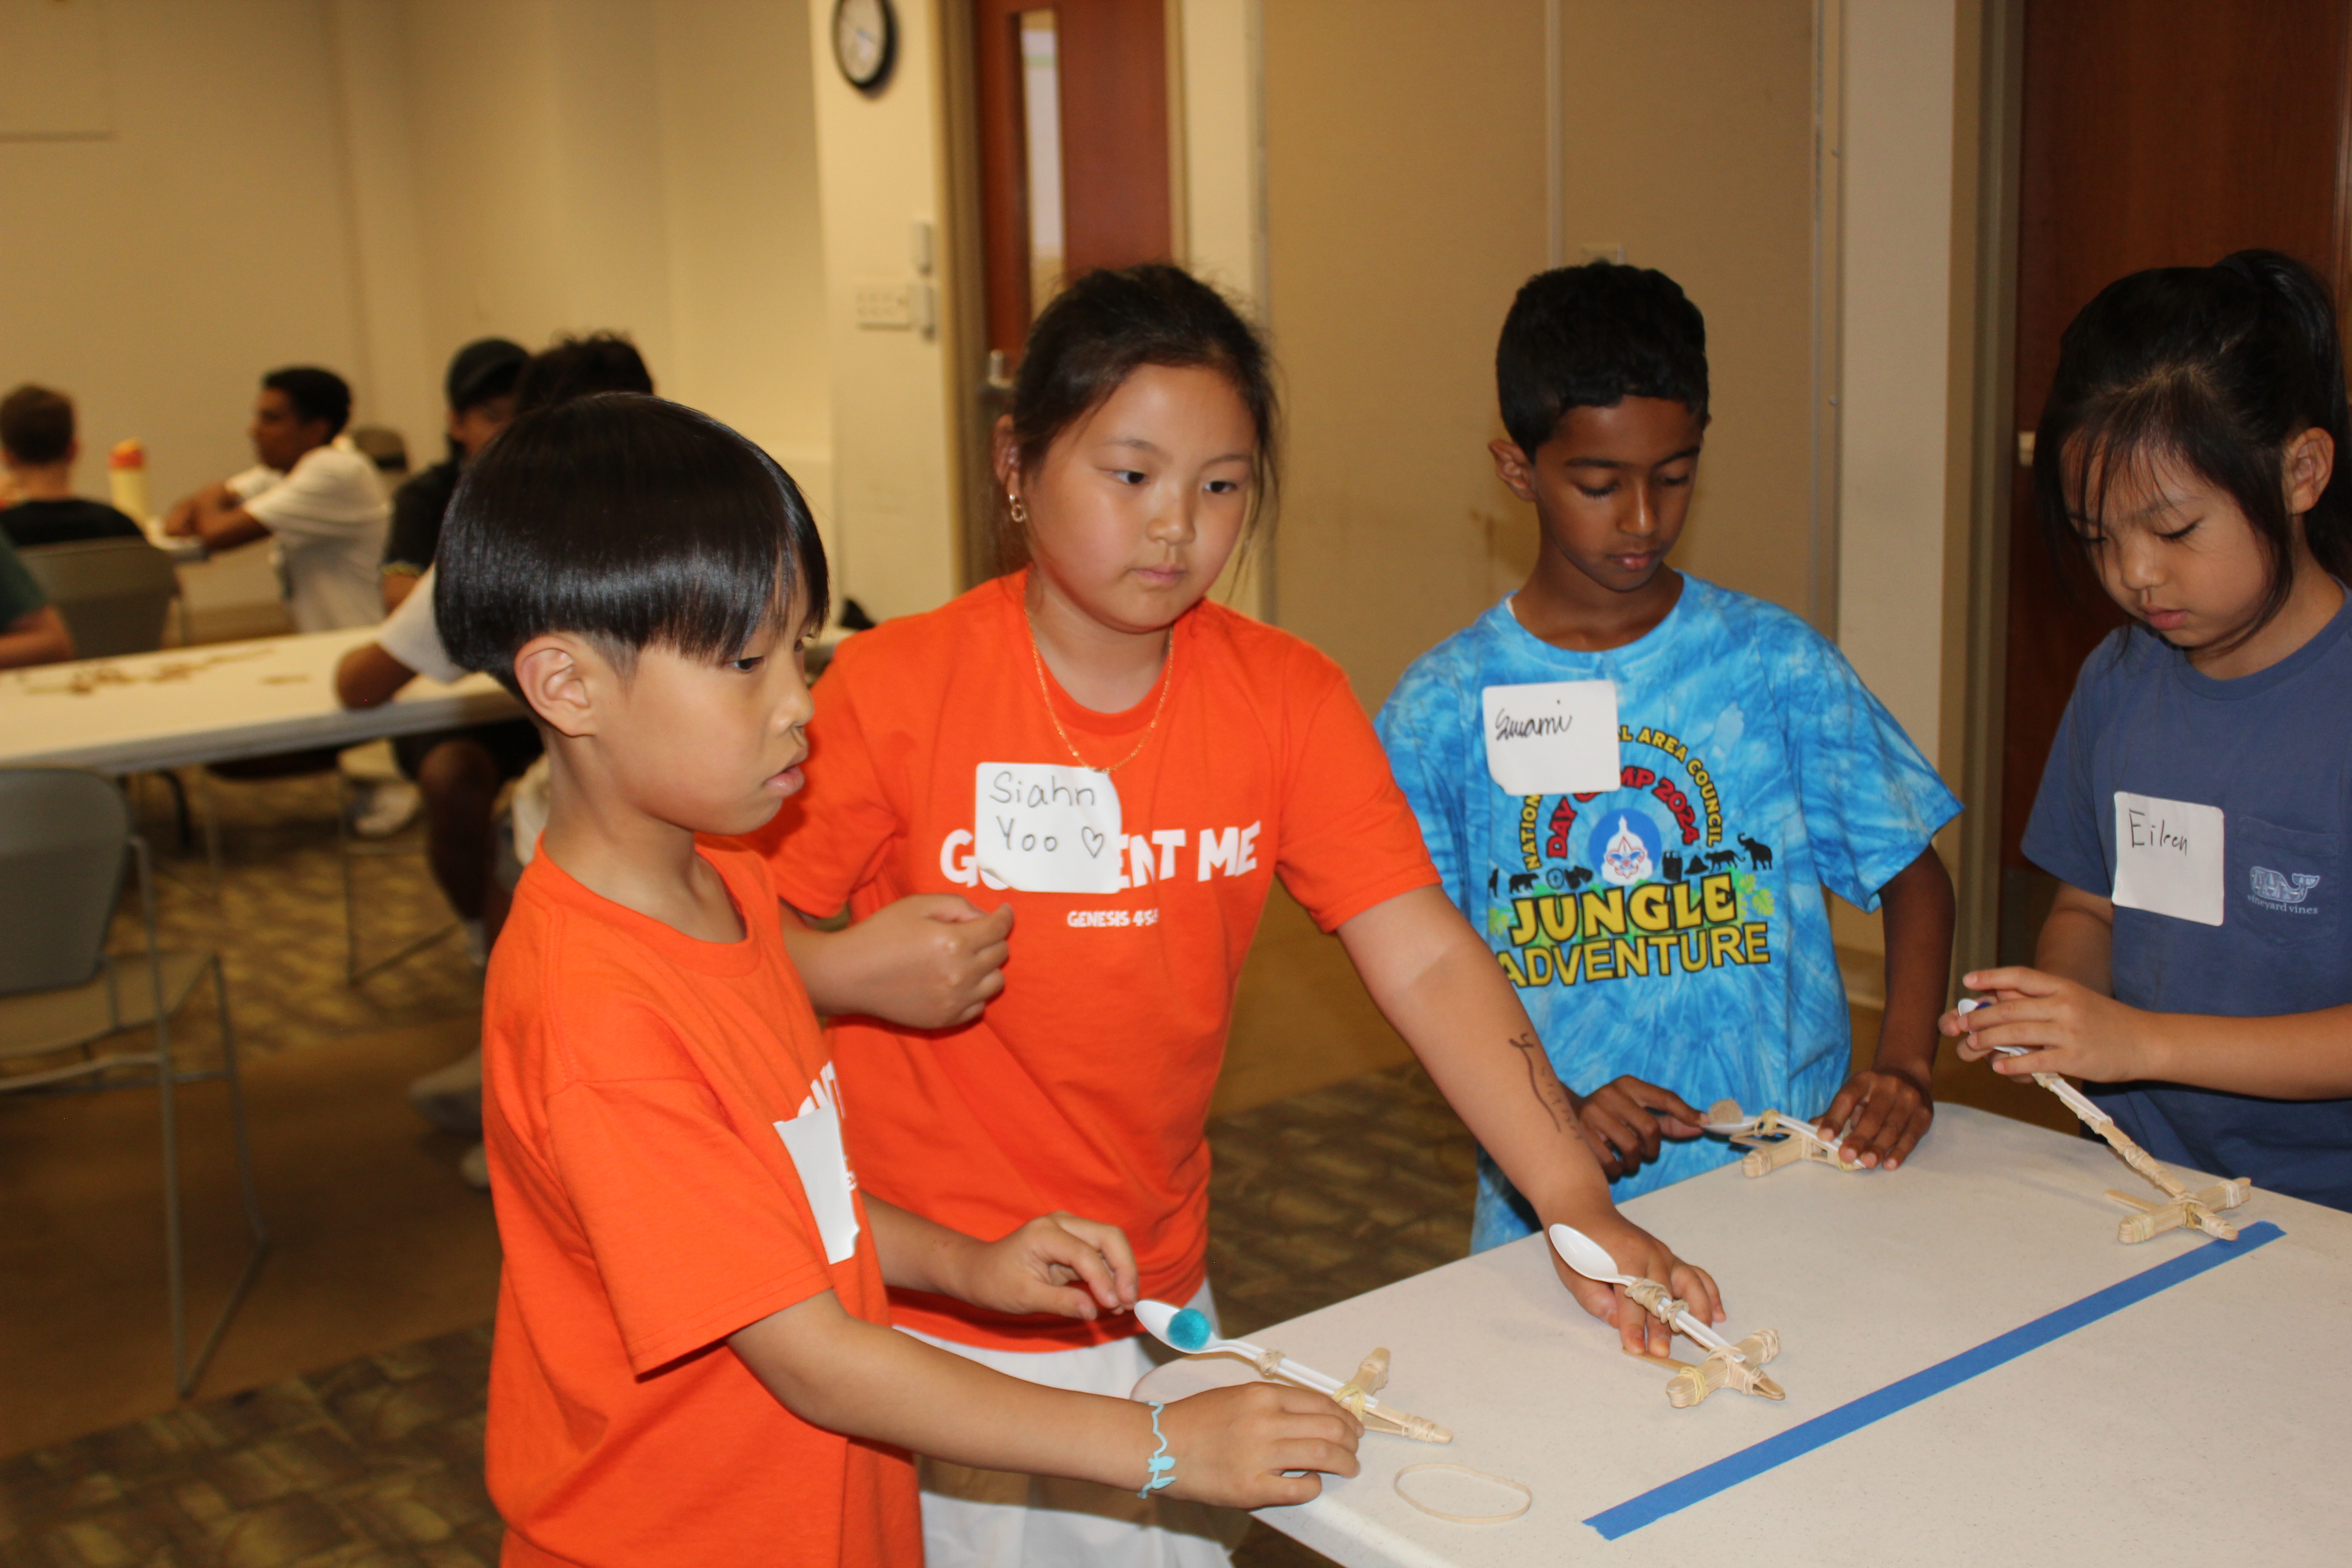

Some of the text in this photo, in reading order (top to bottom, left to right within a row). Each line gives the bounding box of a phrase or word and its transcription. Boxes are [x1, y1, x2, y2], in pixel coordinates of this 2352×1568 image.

[989, 770, 1096, 808] Siahn
[1636, 726, 1689, 763] AREA
[1686, 758, 1723, 847] COUNCIL
[996, 815, 1058, 852] Yoo
[1545, 795, 1578, 859] DAY
[1651, 776, 1700, 845] 2024
[2128, 808, 2187, 857] Eileen
[1197, 820, 1260, 882] ME
[1067, 909, 1130, 927] GENESIS
[1507, 871, 1737, 947] JUNGLE
[2247, 894, 2319, 915] vineyard vines
[1497, 921, 1770, 988] ADVENTURE
